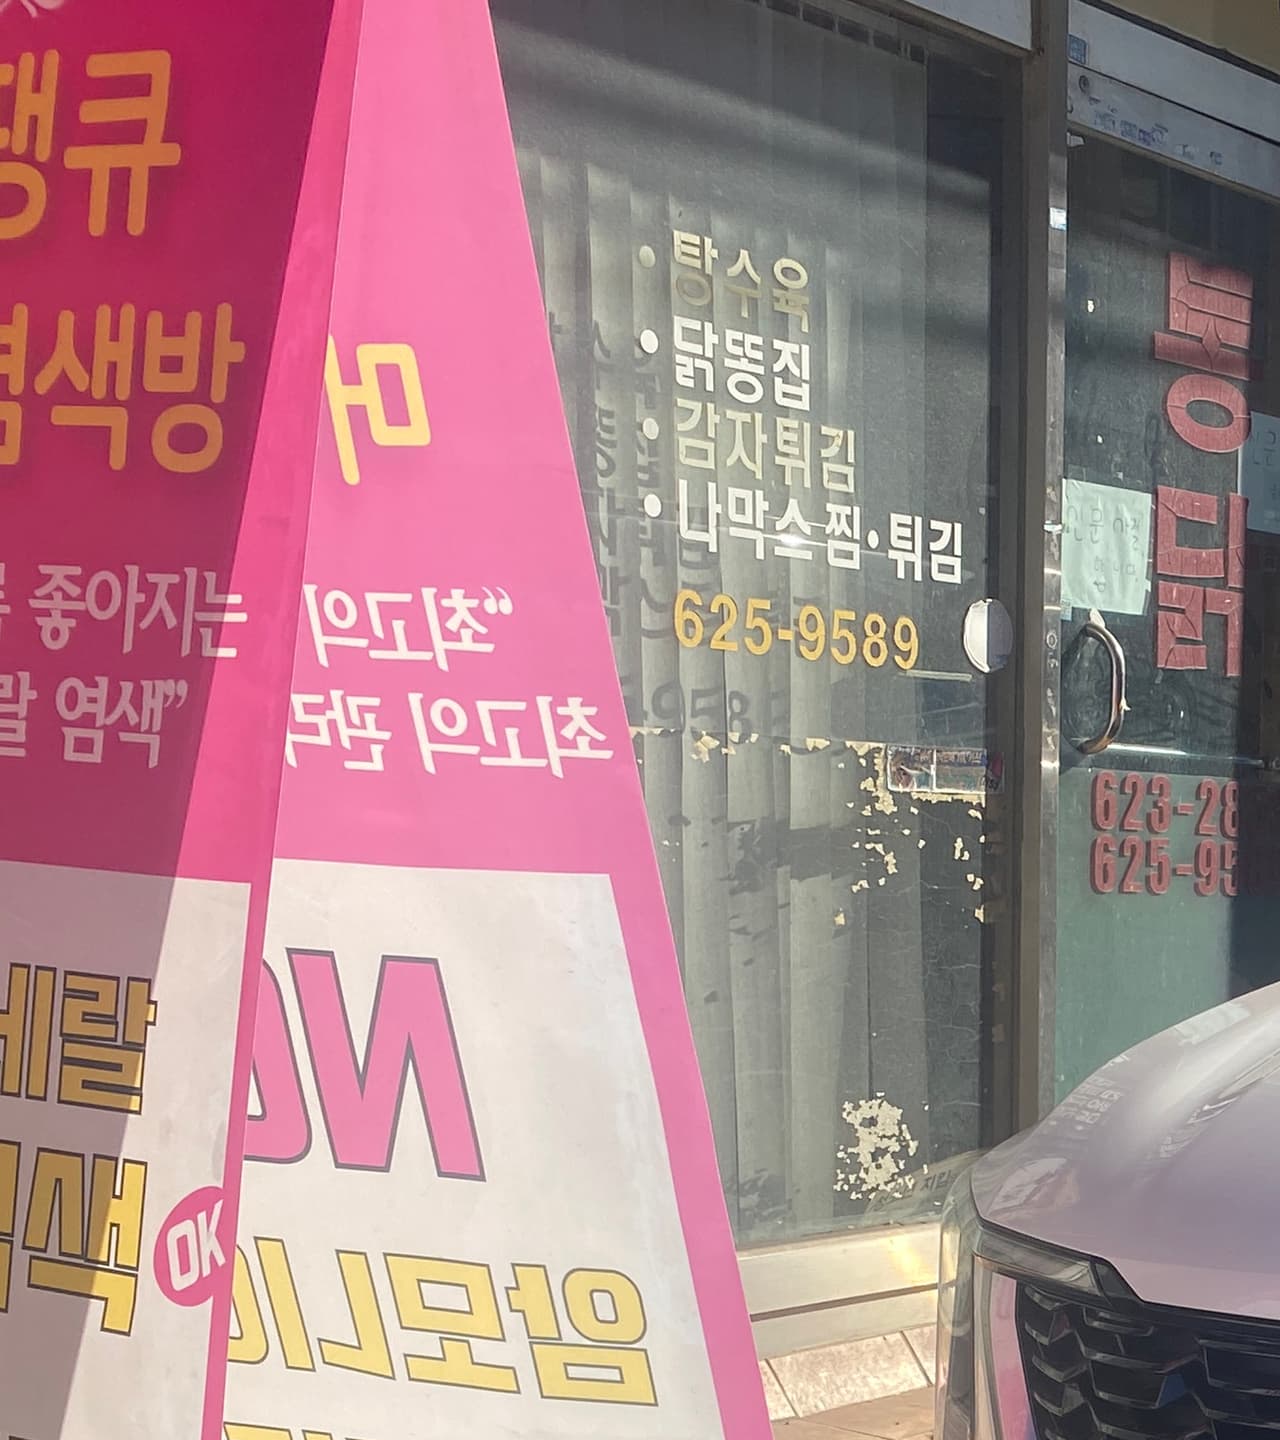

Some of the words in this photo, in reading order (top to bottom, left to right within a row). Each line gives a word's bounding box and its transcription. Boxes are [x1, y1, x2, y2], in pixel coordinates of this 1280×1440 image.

[673, 230, 810, 333] 탕수육
[0, 301, 246, 473] 색방
[673, 315, 811, 412] 닭똥집
[675, 396, 857, 494] 감자튀김
[28, 563, 248, 660] 좋아지는
[674, 588, 920, 671] 625-9589
[0, 1139, 149, 1336] 색
[166, 1198, 226, 1288] OK
